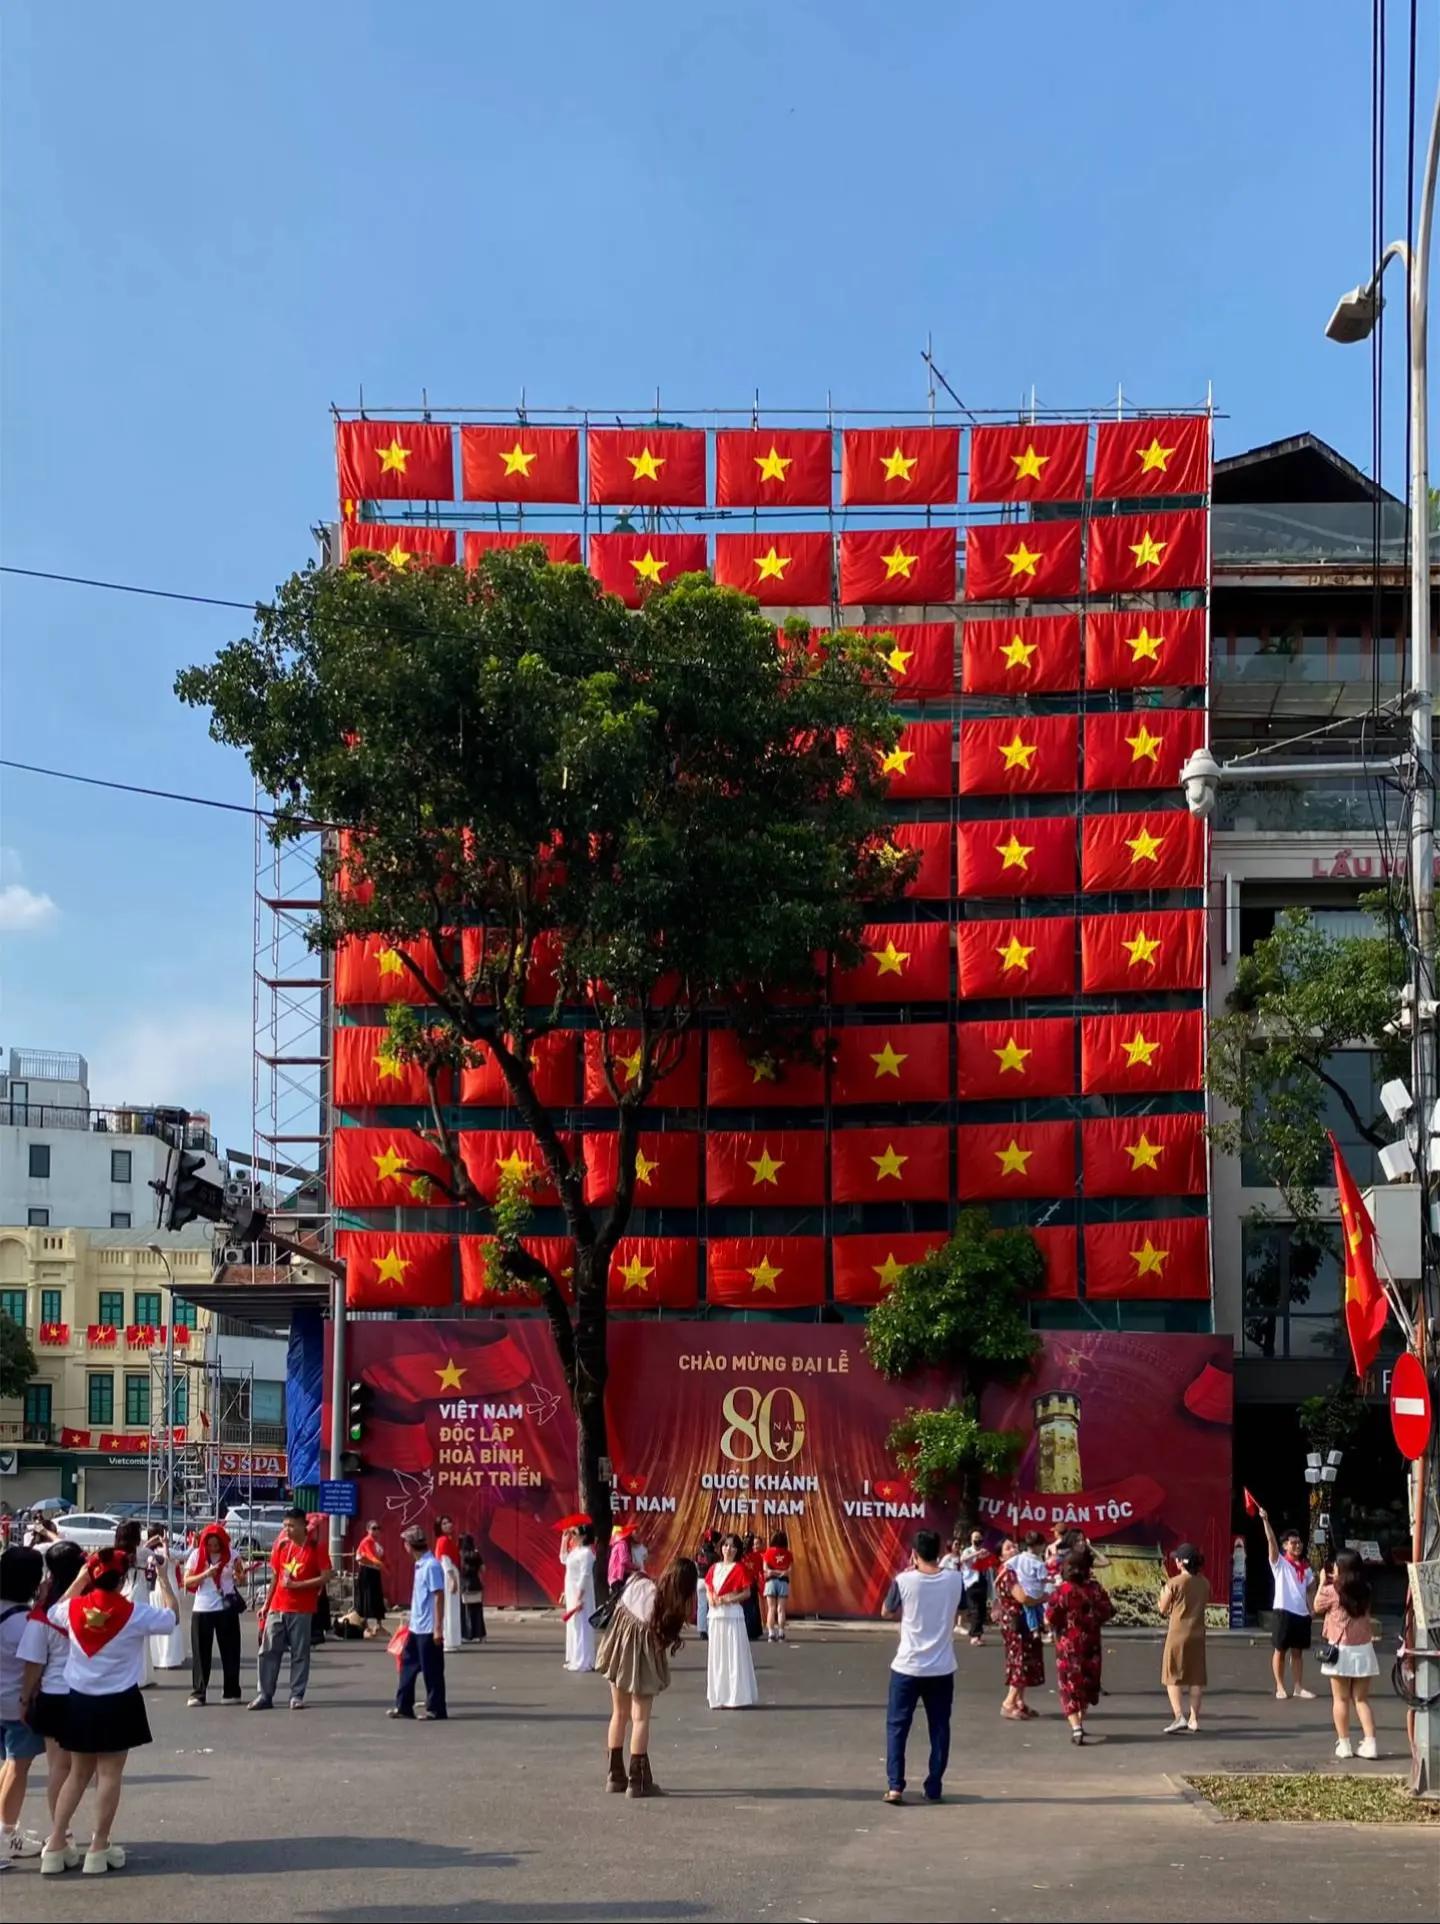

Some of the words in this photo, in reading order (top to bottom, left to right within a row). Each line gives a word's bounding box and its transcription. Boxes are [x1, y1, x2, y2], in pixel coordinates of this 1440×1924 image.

[678, 1351, 727, 1371] CHÀO
[732, 1351, 787, 1372] MỪNG
[792, 1356, 821, 1376] ĐẠI
[827, 1349, 849, 1373] LỄ
[439, 1399, 479, 1423] VIỆT
[483, 1403, 523, 1419] NAM
[440, 1422, 475, 1446] ĐỘC
[480, 1422, 514, 1445] LẬP
[720, 1386, 806, 1463] 80
[440, 1444, 475, 1464] HOÀ
[481, 1444, 523, 1464] BÌNH
[438, 1466, 484, 1486] PHÁT
[488, 1465, 541, 1486] TRIỂN
[702, 1468, 750, 1489] QUỐC
[755, 1470, 819, 1491] KHÁNH
[864, 1479, 869, 1495] I
[609, 1491, 631, 1515] ỆT
[636, 1495, 676, 1512] NAM
[719, 1493, 759, 1518] VIỆT
[764, 1499, 804, 1515] NAM
[844, 1501, 926, 1518] VIETNAM
[977, 1496, 1004, 1518] TỰ
[1052, 1502, 1090, 1522] DÂN
[1095, 1499, 1133, 1523] TỘC
